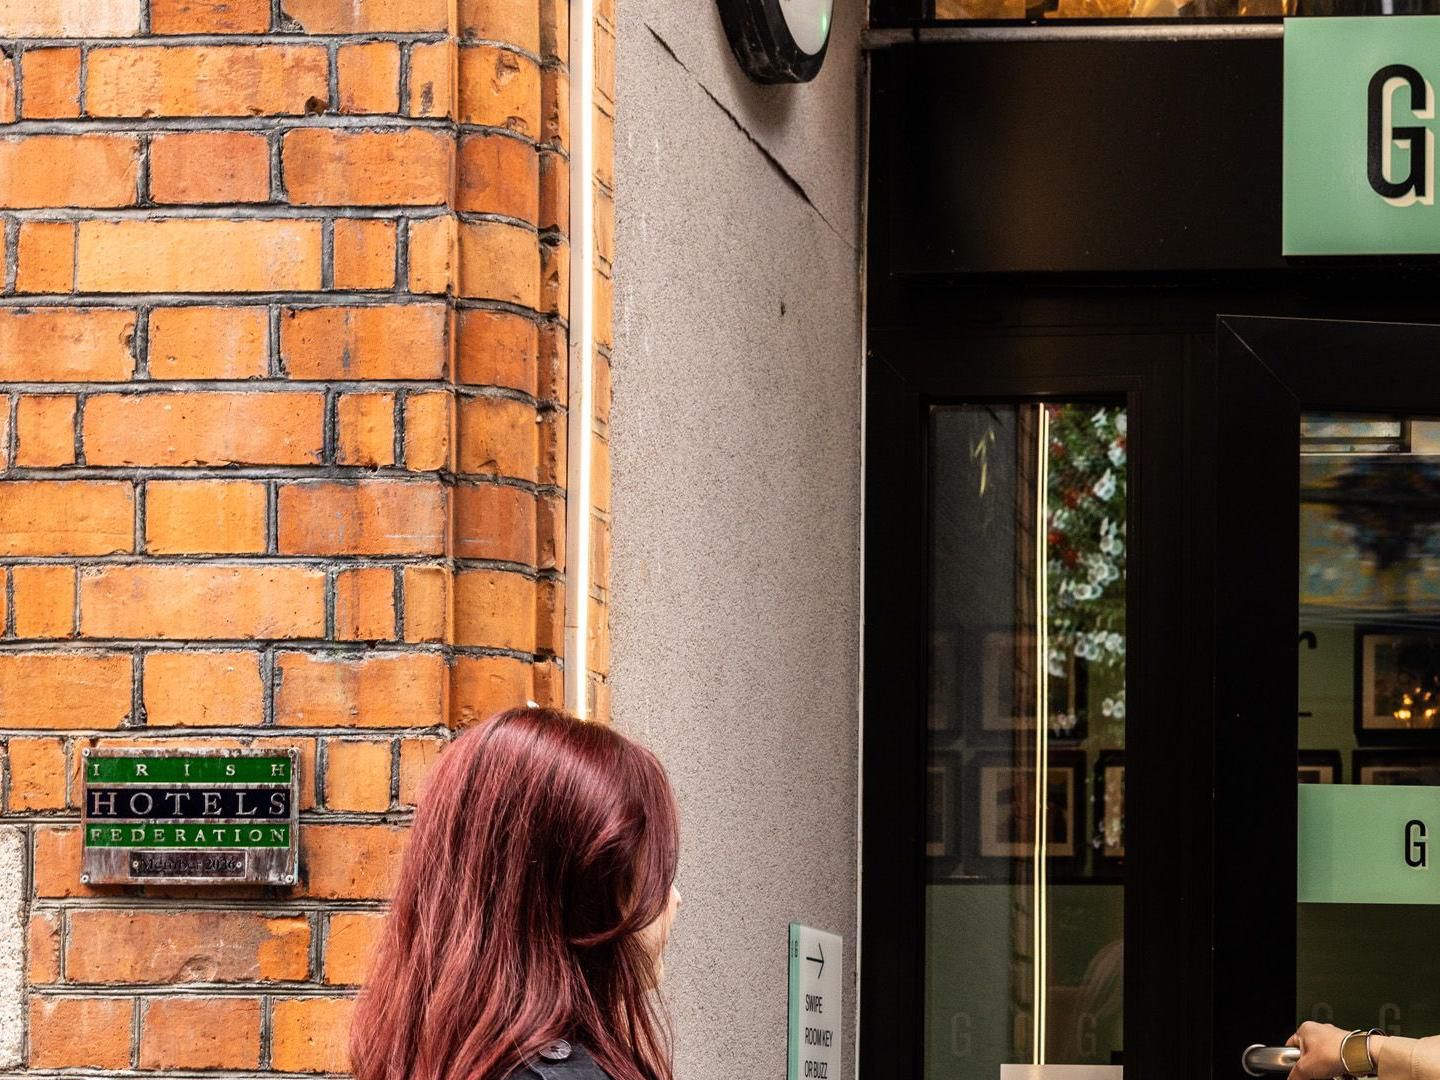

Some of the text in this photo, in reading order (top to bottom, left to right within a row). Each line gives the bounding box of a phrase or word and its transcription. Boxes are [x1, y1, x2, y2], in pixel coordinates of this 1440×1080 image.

[1367, 63, 1435, 207] G
[93, 763, 286, 777] IRISH
[92, 792, 286, 816] HOTELS
[91, 829, 286, 842] FEDERATION
[1404, 819, 1428, 870] G
[805, 993, 823, 1014] SWIPE
[805, 1026, 834, 1048] ROOM KEY
[804, 1060, 828, 1080] OR BUZZ
